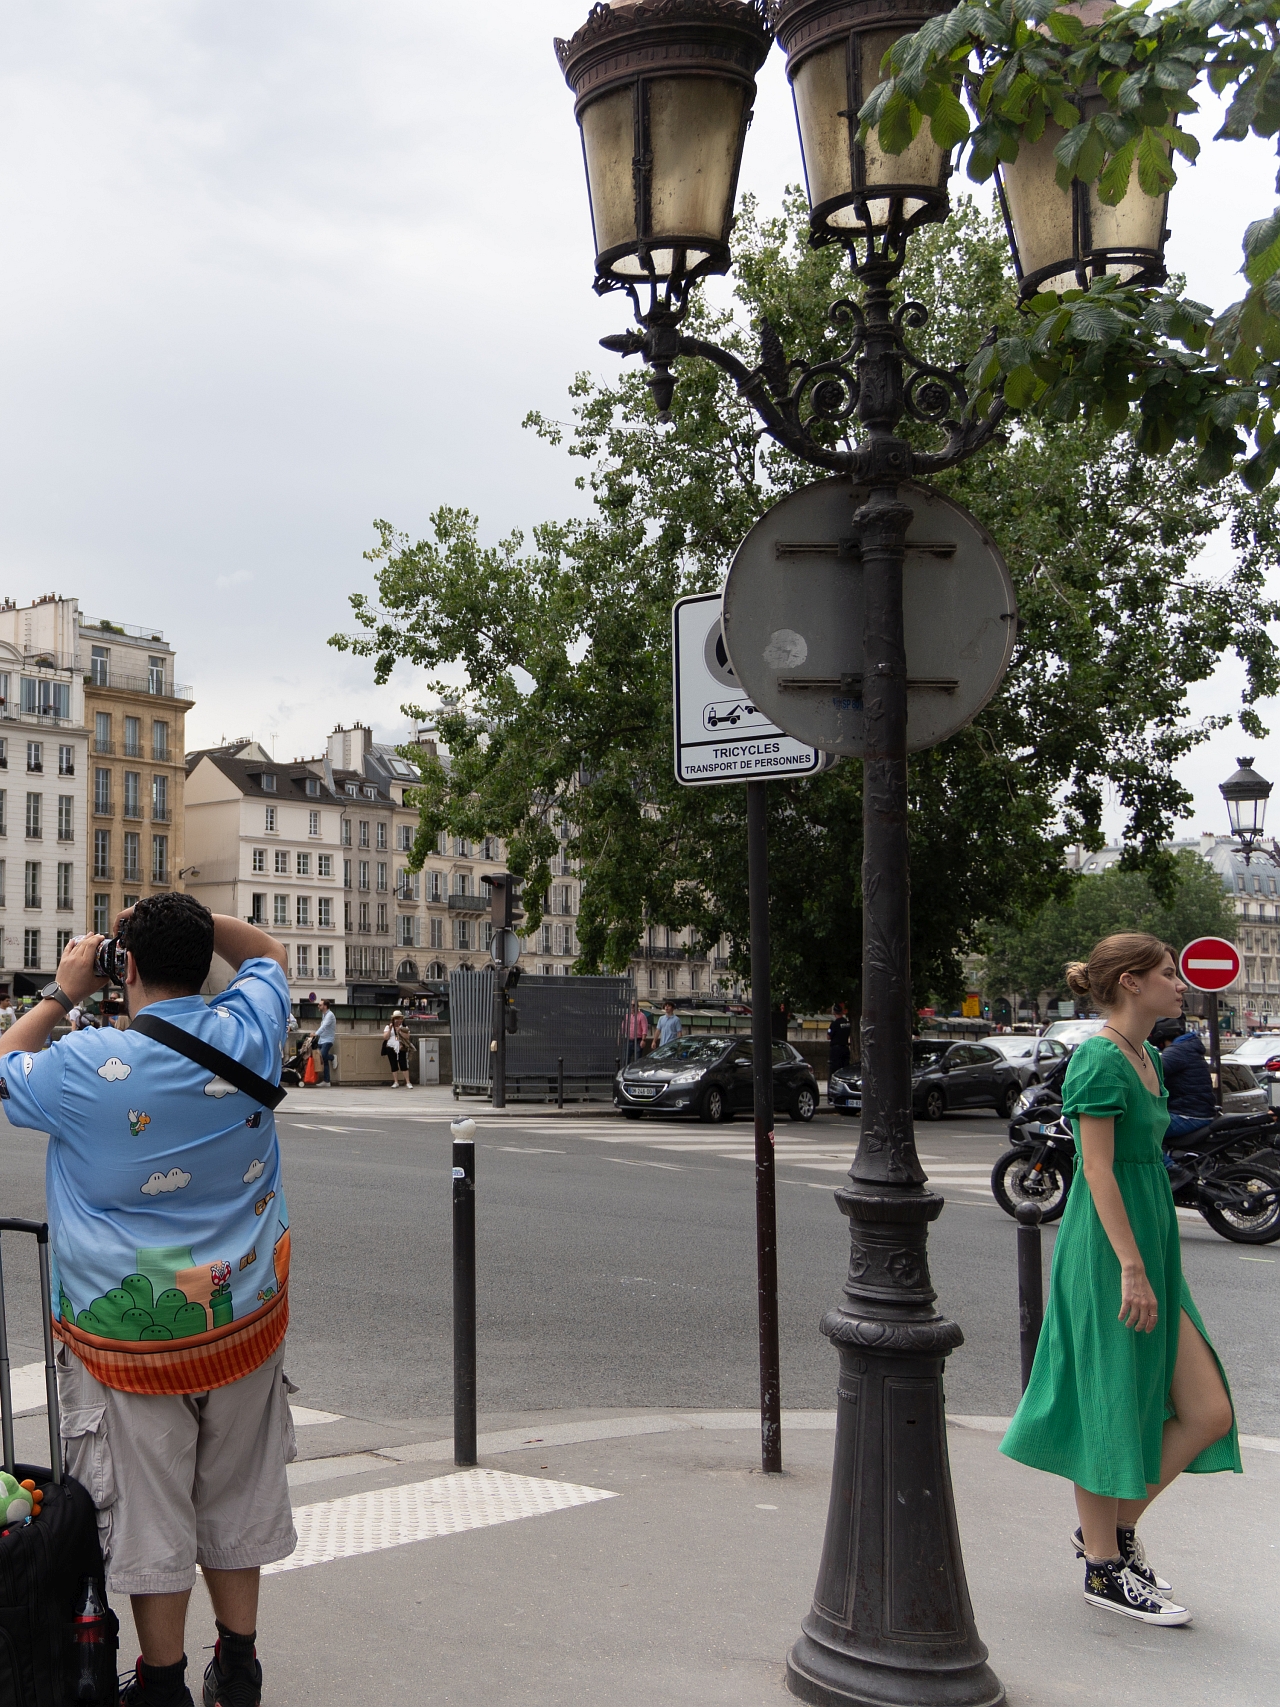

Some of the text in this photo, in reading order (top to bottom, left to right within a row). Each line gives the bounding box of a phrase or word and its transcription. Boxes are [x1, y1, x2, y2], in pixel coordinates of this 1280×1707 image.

[713, 743, 780, 758] TRICYCLES
[685, 754, 811, 774] TRANSPORT DE PERSONNES
